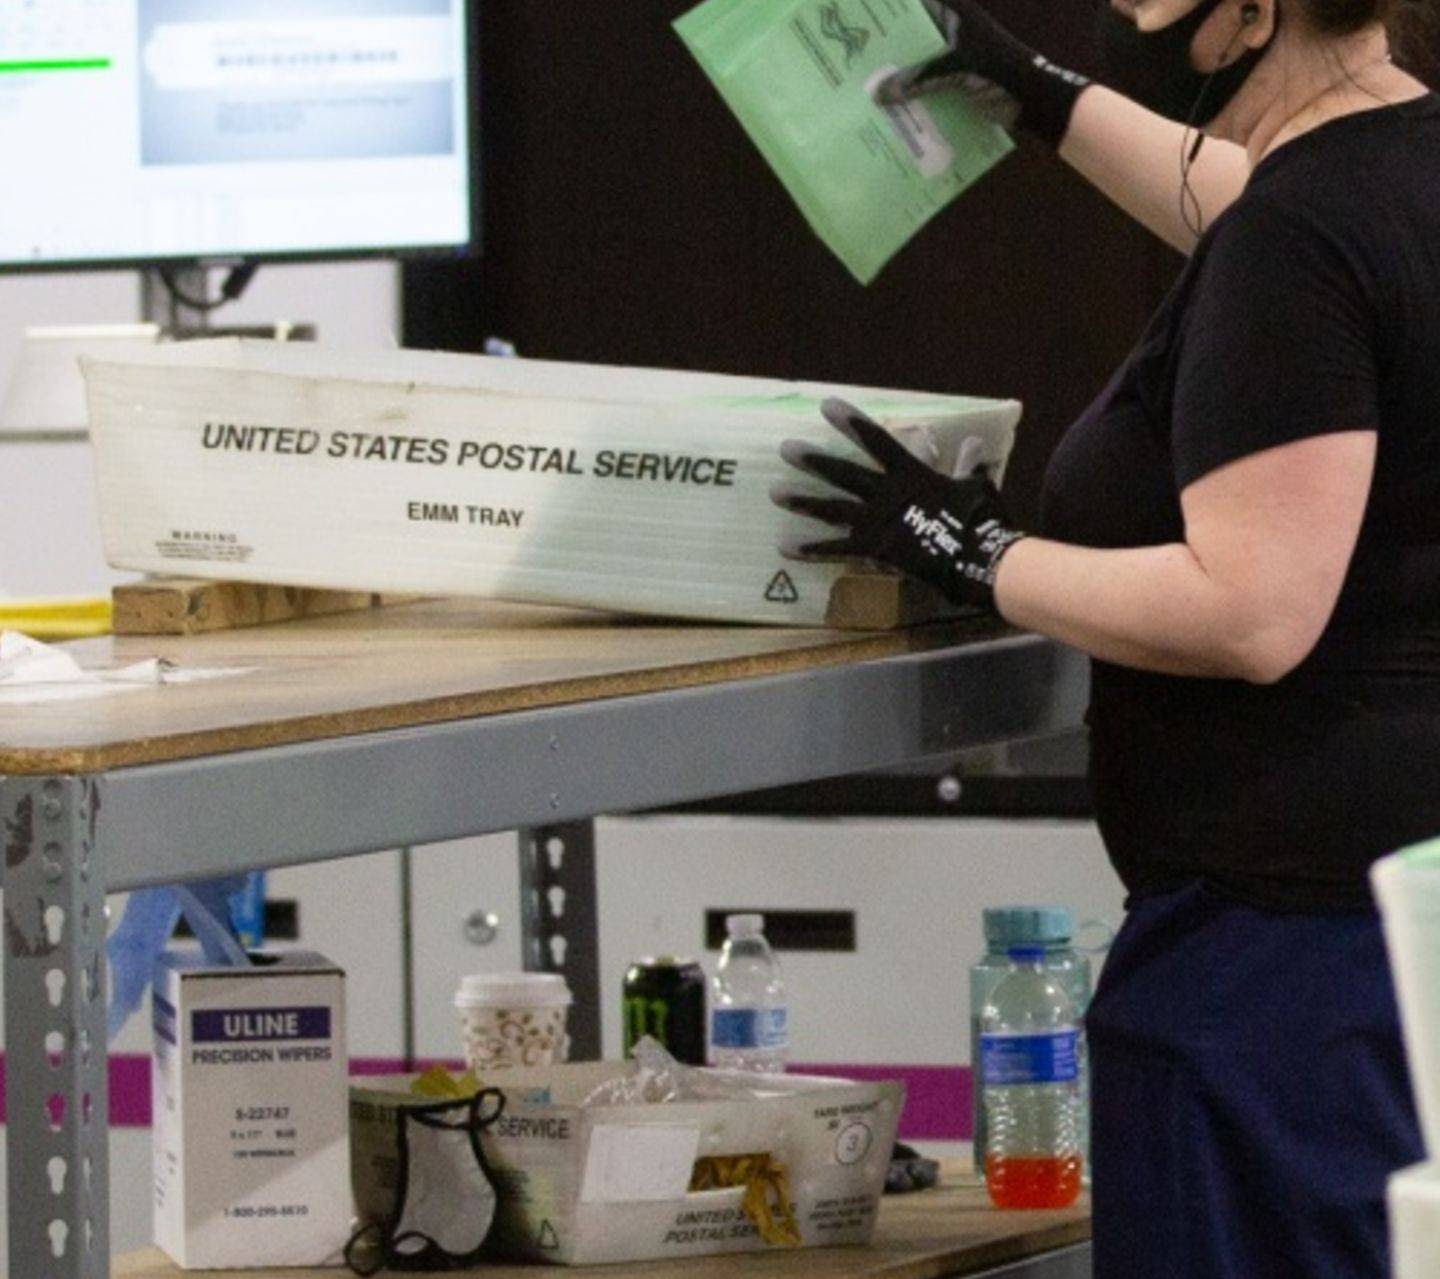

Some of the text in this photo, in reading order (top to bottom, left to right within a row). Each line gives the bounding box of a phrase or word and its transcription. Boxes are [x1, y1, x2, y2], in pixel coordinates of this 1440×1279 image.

[201, 422, 738, 488] UNITED STATES POSTAL SERVICE
[408, 501, 524, 527] EMM TRAY
[172, 530, 238, 544] WARNING
[904, 505, 962, 556] HyFlex
[223, 1012, 299, 1037] ULINE
[193, 1046, 332, 1064] PRECISION WIPERS
[497, 1119, 570, 1140] SERVICE
